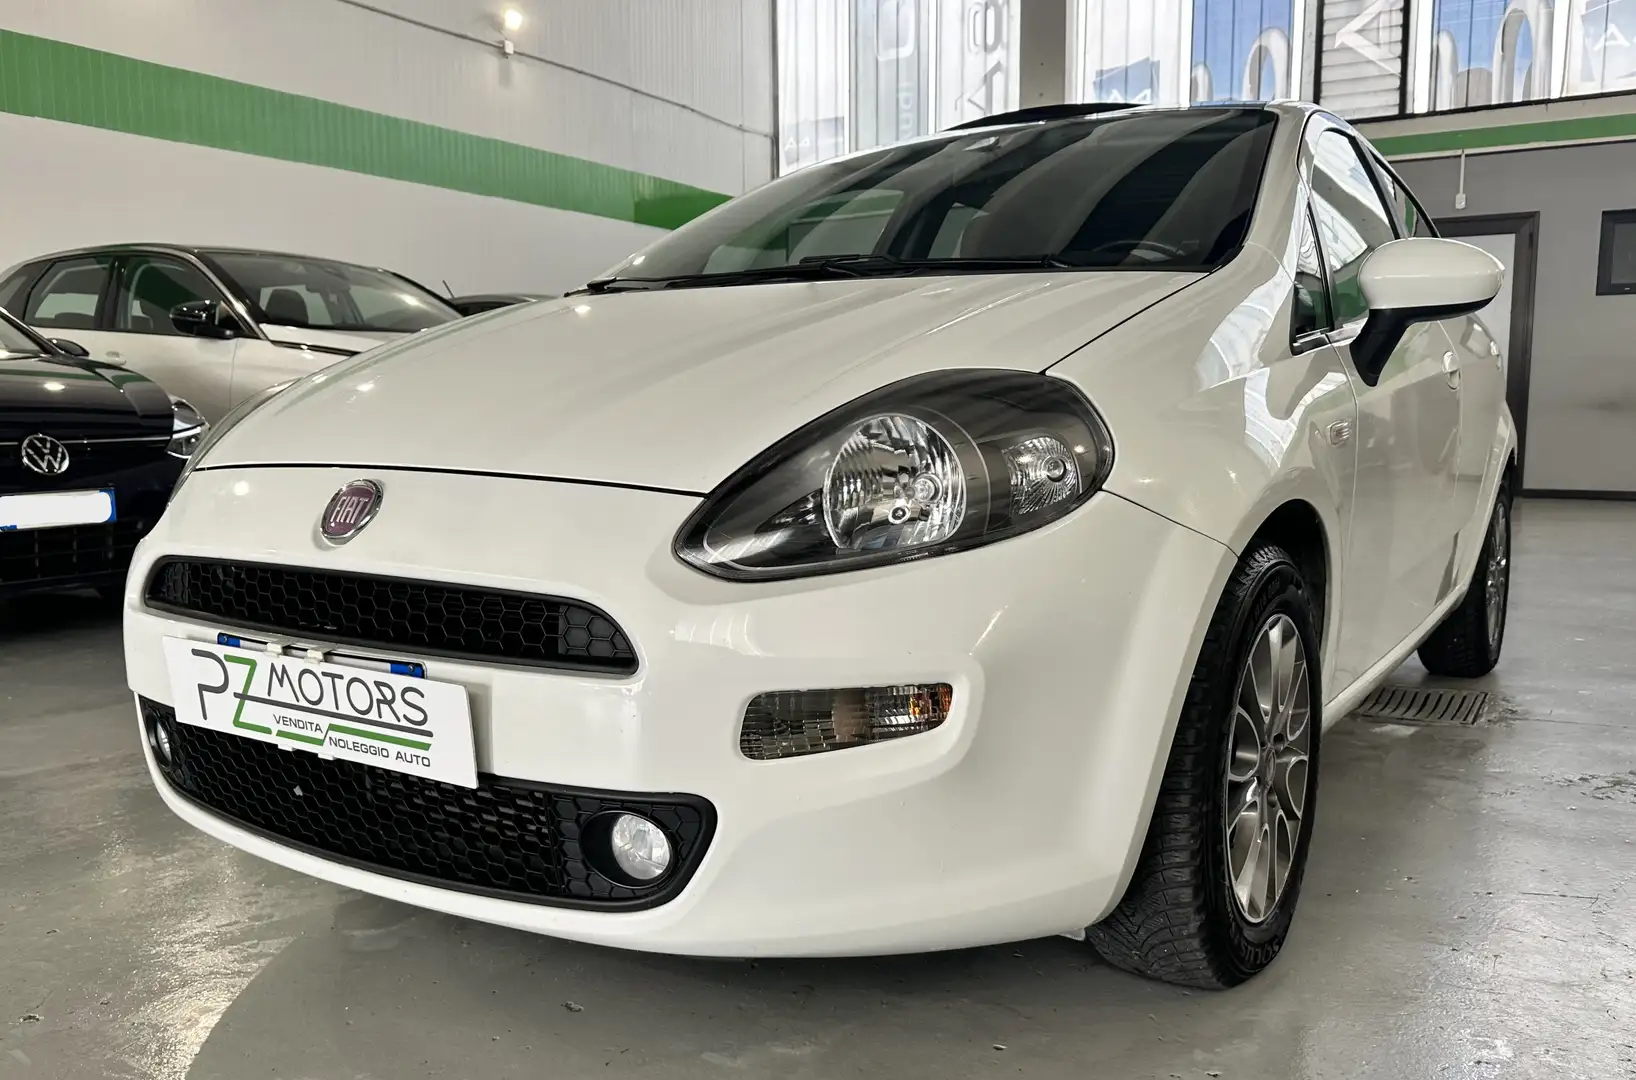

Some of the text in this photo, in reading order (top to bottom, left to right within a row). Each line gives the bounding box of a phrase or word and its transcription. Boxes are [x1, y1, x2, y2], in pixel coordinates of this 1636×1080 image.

[330, 496, 370, 523] FIAT
[191, 648, 429, 735] PZ MOTORS
[272, 713, 324, 734] VENDITA
[328, 735, 431, 768] NOLEGGIO AUTO
